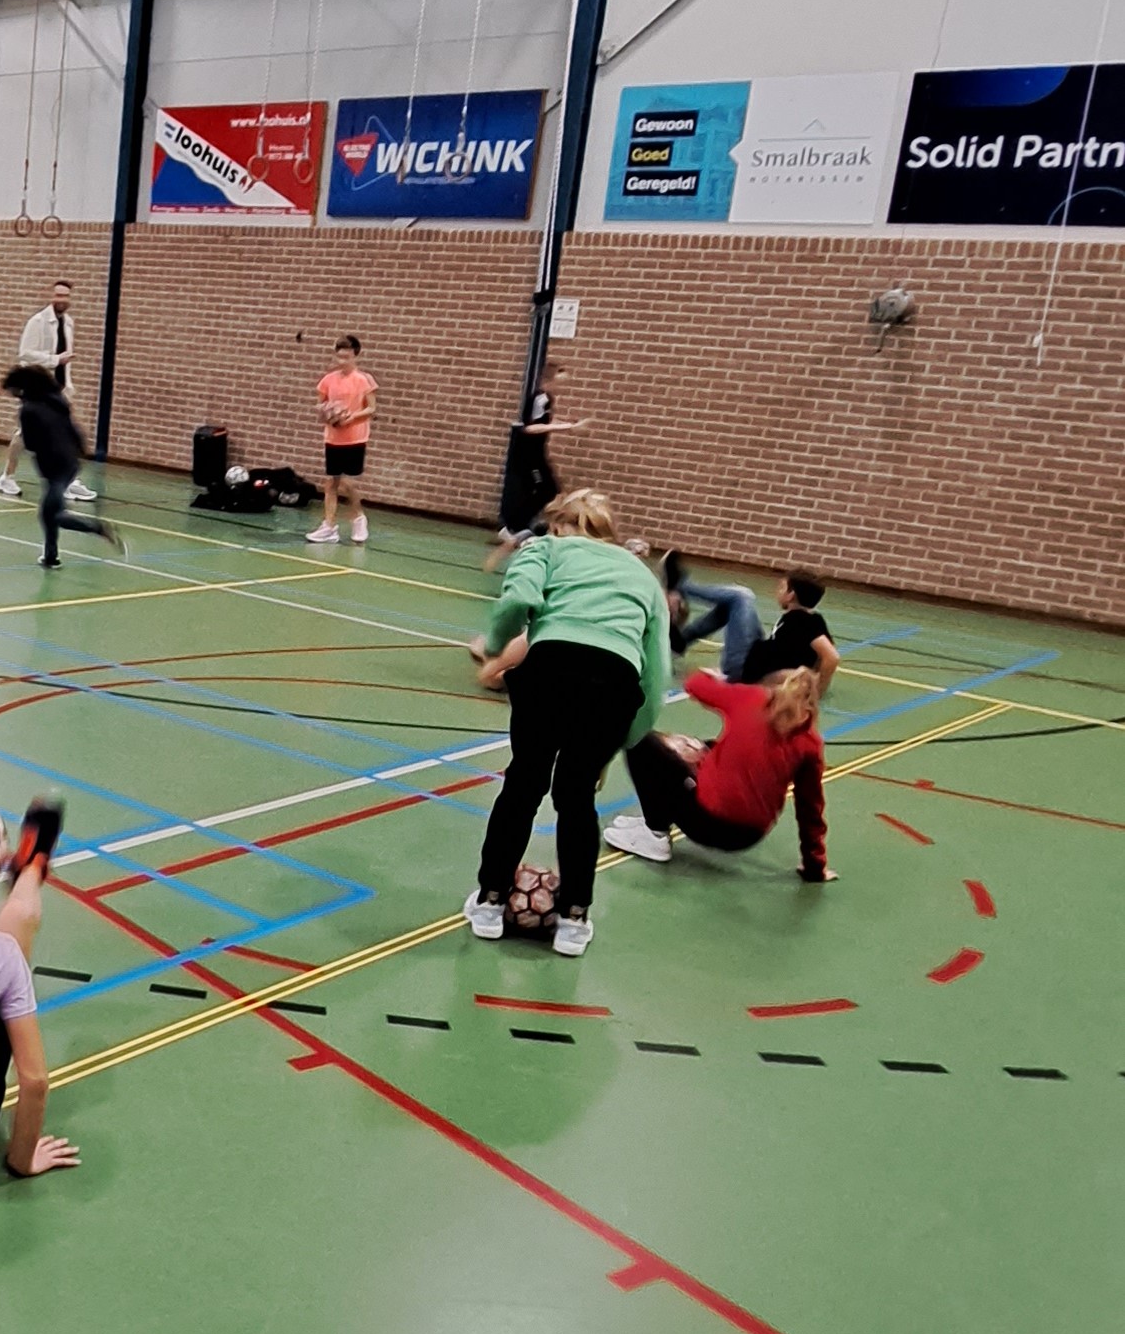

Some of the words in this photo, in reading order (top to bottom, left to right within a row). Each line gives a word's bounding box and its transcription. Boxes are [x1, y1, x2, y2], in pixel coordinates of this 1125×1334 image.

[635, 118, 694, 132] Gewoon
[174, 127, 240, 185] loohuis
[376, 139, 534, 174] WICHINK
[631, 147, 670, 162] Goed
[751, 146, 873, 167] Smalbraak
[906, 135, 1005, 168] Solid
[1013, 134, 1125, 168] Partn
[626, 175, 697, 194] Geregeld!
